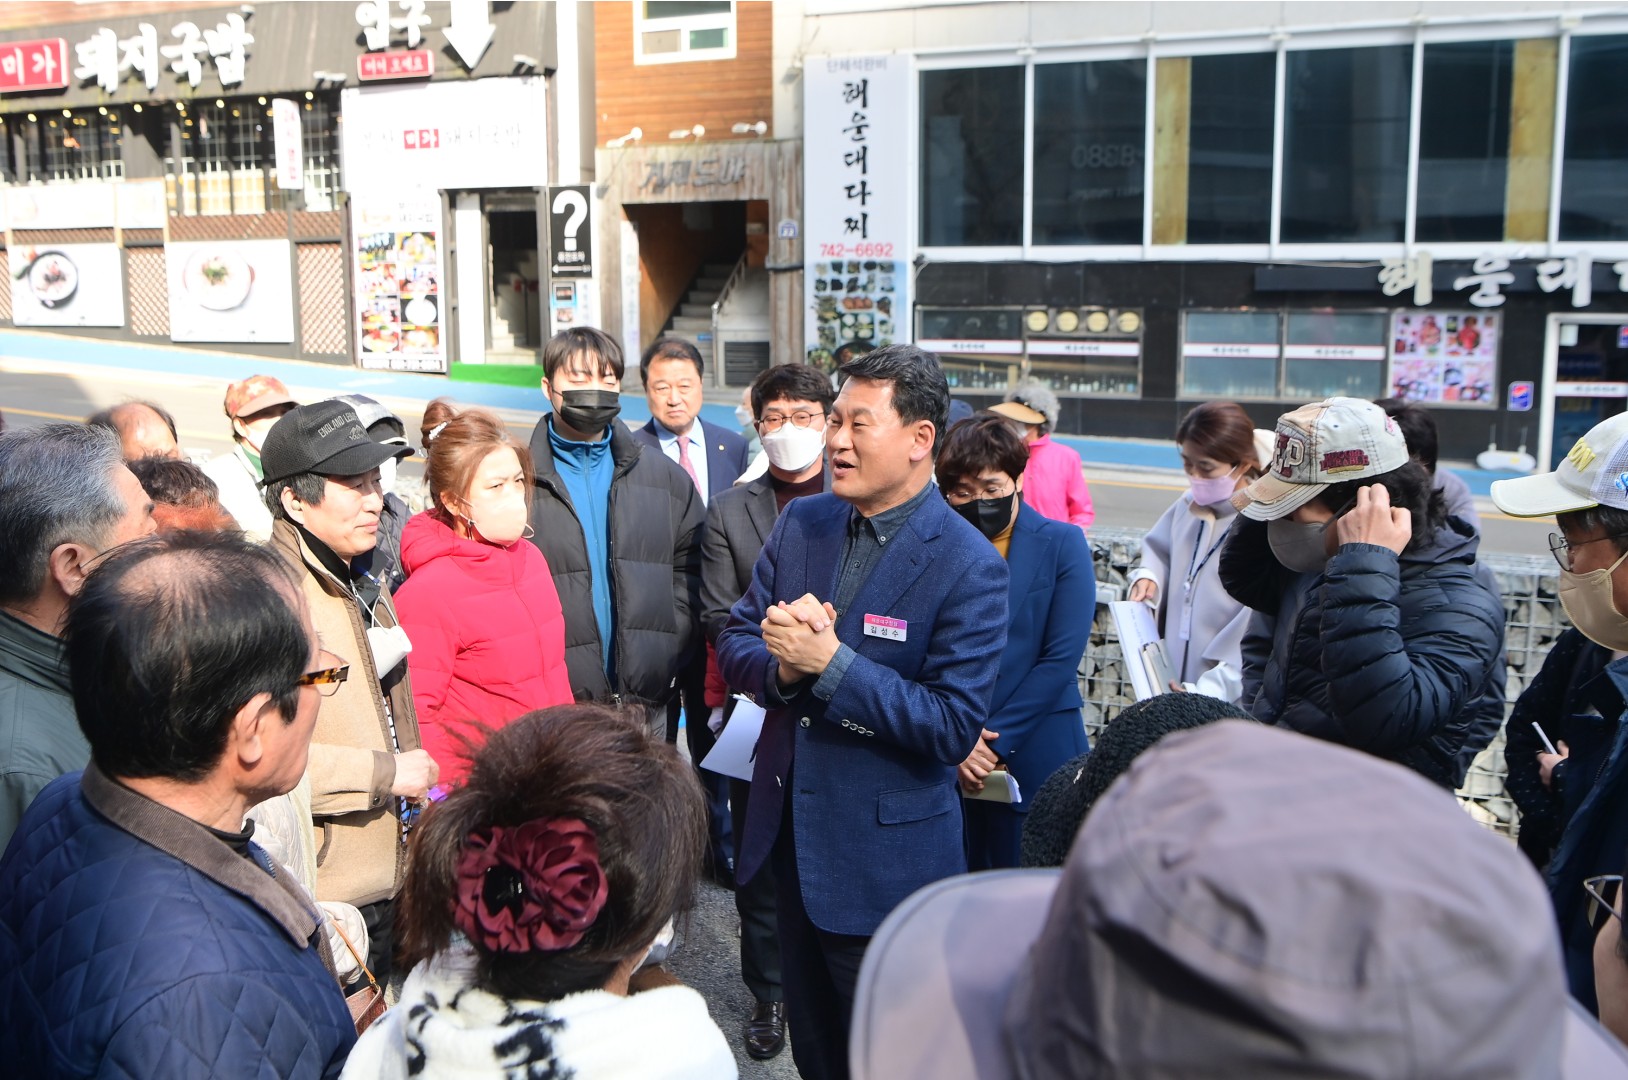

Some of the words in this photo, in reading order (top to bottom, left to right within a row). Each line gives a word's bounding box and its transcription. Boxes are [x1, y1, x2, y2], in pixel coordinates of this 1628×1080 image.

[1, 44, 57, 85] 미가
[74, 13, 255, 93] 돼지국밥
[355, 1, 432, 50] 입구
[552, 189, 588, 251] ?
[820, 243, 894, 257] 742-6692
